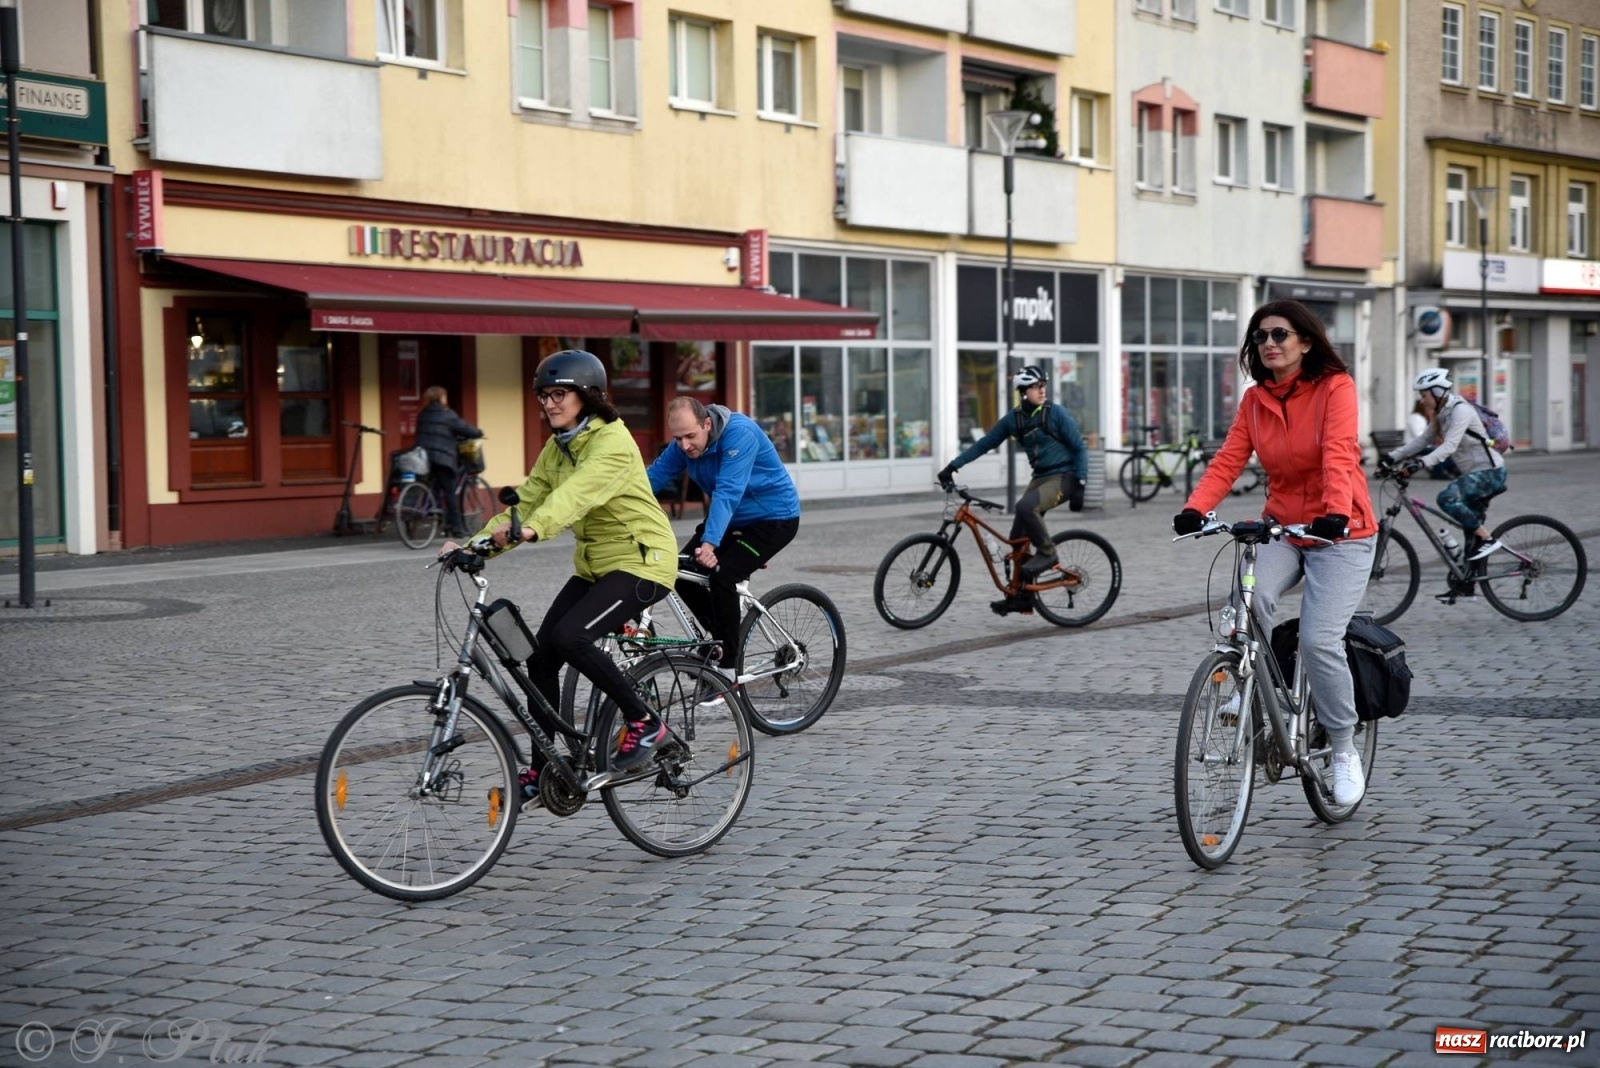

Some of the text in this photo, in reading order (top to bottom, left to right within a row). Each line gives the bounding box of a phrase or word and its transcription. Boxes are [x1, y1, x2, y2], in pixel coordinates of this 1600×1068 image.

[19, 86, 82, 111] FINANSE
[138, 177, 152, 240] ŻYWIEC
[386, 228, 583, 267] RESTAURACJA
